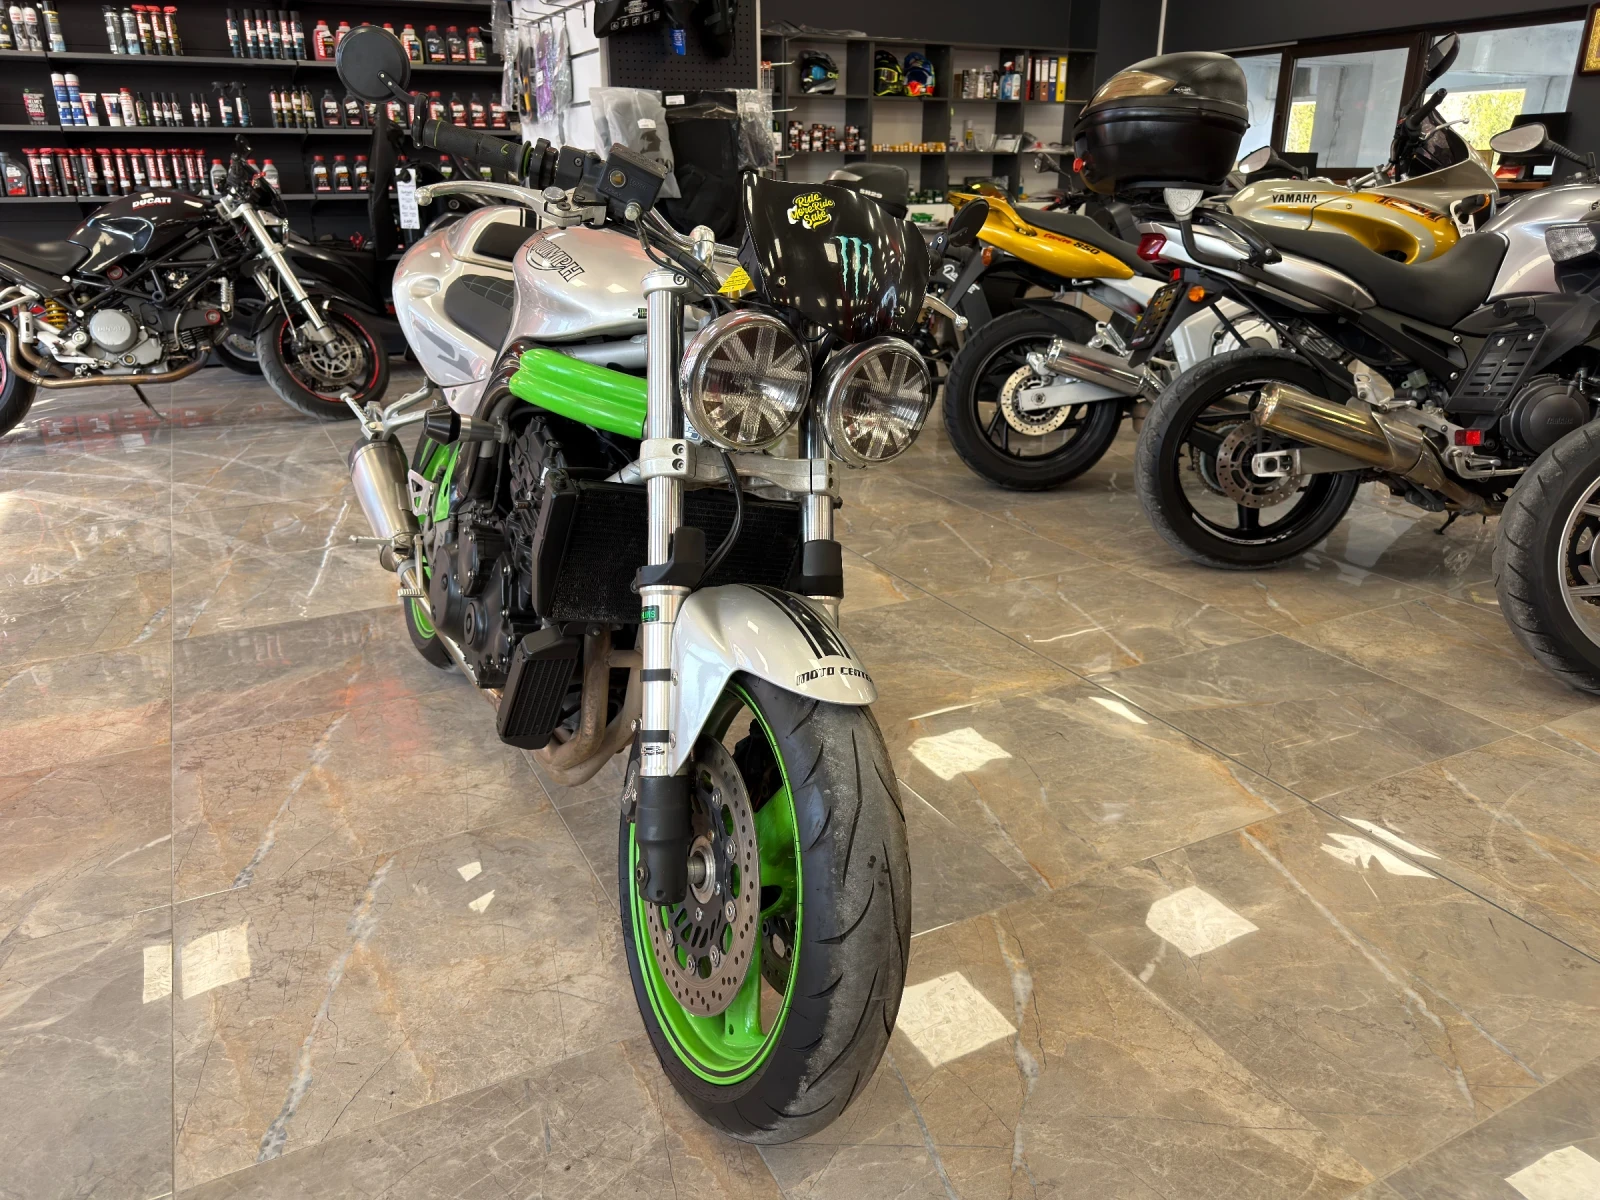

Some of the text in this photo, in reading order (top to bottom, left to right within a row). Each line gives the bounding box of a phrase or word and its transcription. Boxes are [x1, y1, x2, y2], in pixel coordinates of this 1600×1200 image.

[62, 157, 71, 179] MOTUL
[116, 157, 125, 178] MOTUL
[132, 197, 172, 208] DUCATI
[795, 193, 821, 207] Ride
[1272, 194, 1318, 204] YAMAHA
[790, 198, 834, 220] More Ride
[803, 211, 827, 227] Safe
[1073, 241, 1100, 255] 850
[796, 666, 835, 686] MOTO
